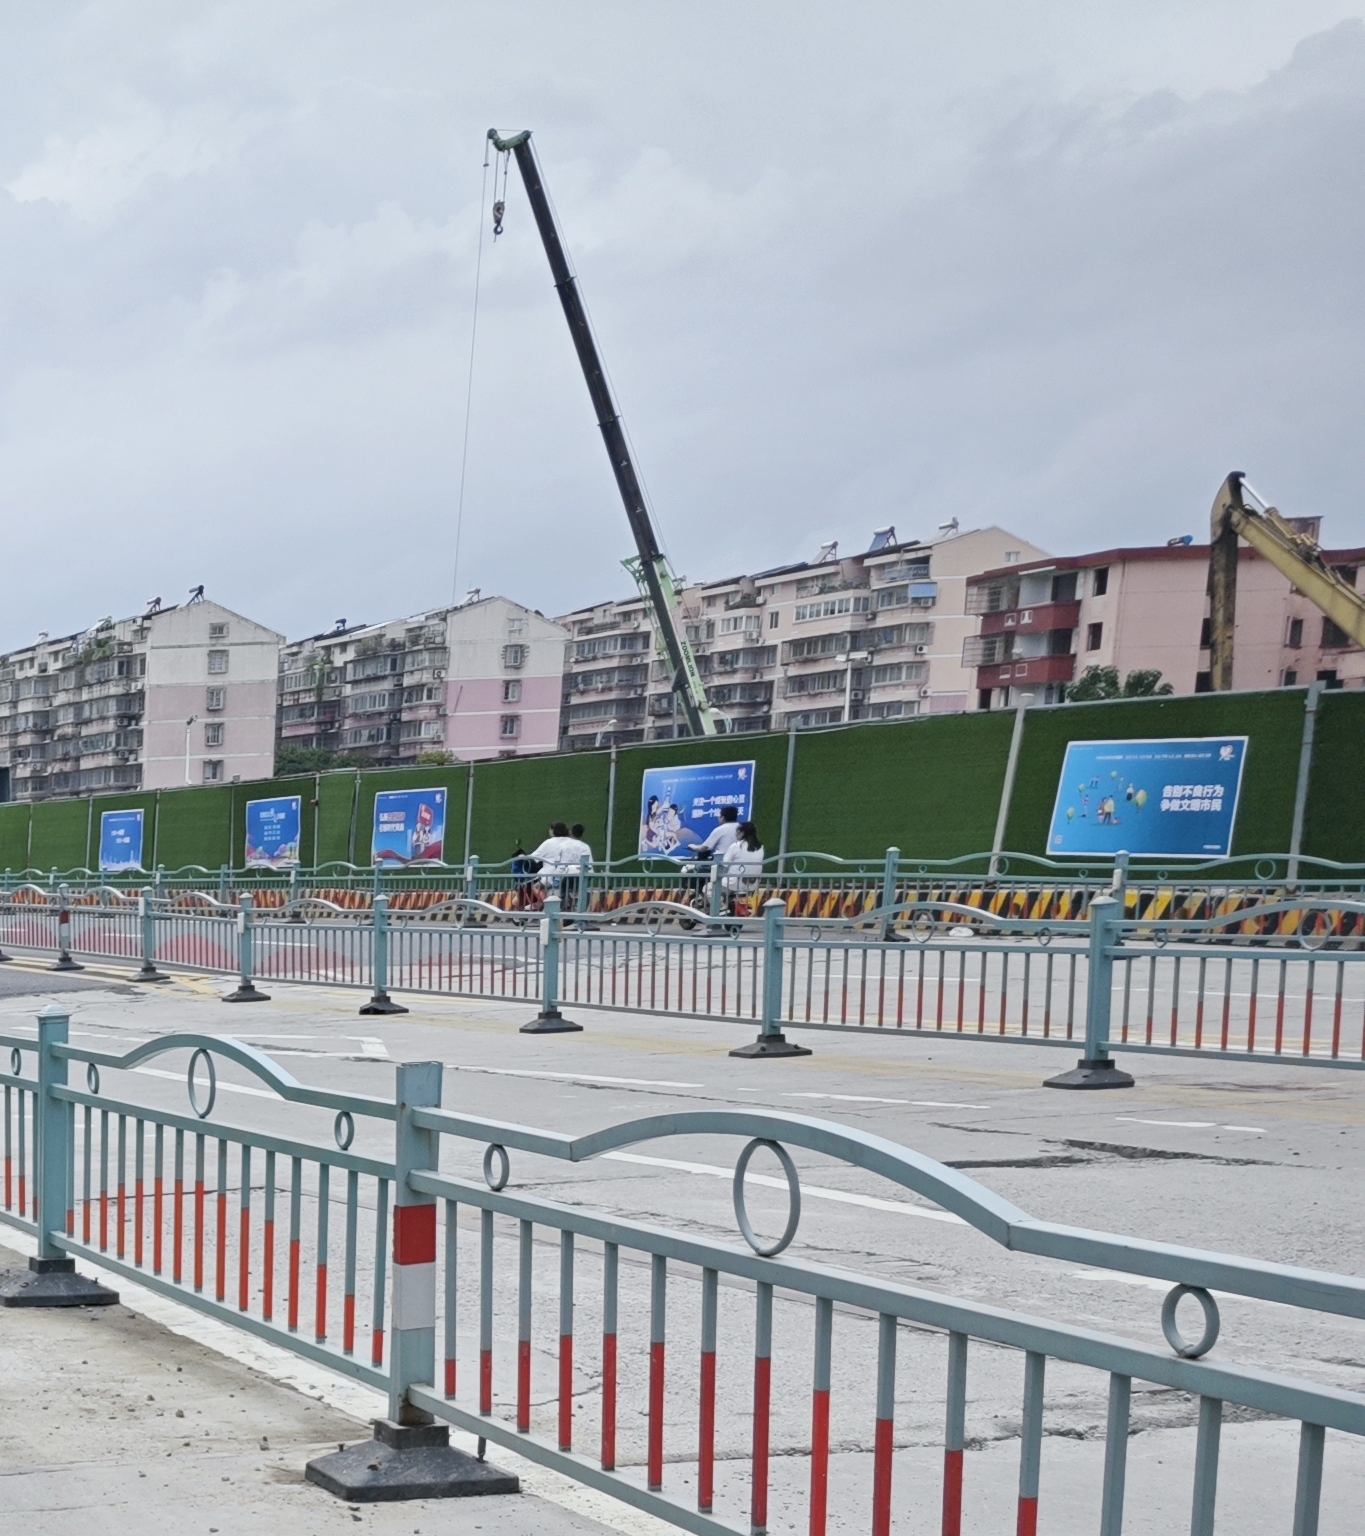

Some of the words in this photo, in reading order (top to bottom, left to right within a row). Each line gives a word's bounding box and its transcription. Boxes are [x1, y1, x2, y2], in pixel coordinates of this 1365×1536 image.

[1162, 785, 1225, 798] 告别不良行为
[1160, 799, 1222, 812] 争做文明市民
